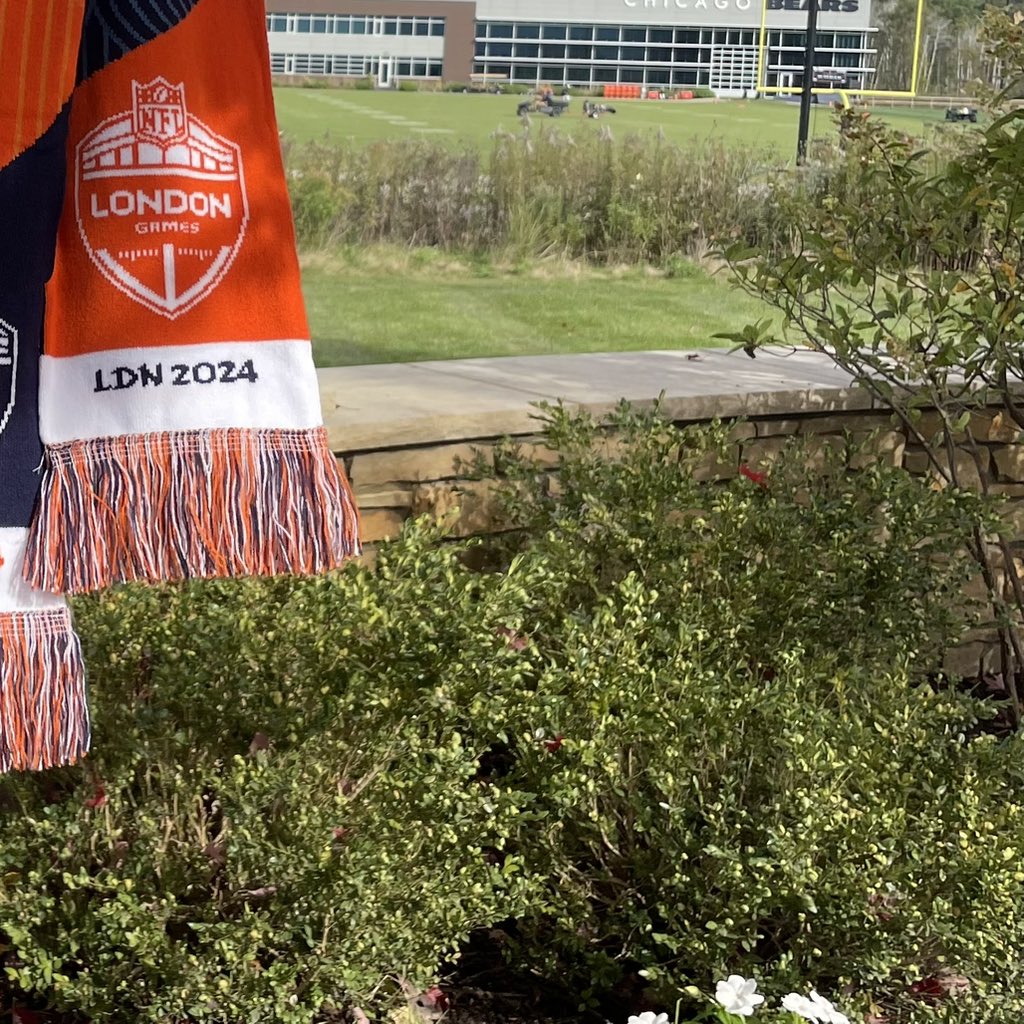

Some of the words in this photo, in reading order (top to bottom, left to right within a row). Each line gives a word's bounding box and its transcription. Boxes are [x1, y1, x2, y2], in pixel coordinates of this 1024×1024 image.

[91, 189, 232, 218] LONDON
[135, 221, 200, 234] GAMES
[94, 362, 163, 393] LDN
[171, 359, 259, 385] 2024
